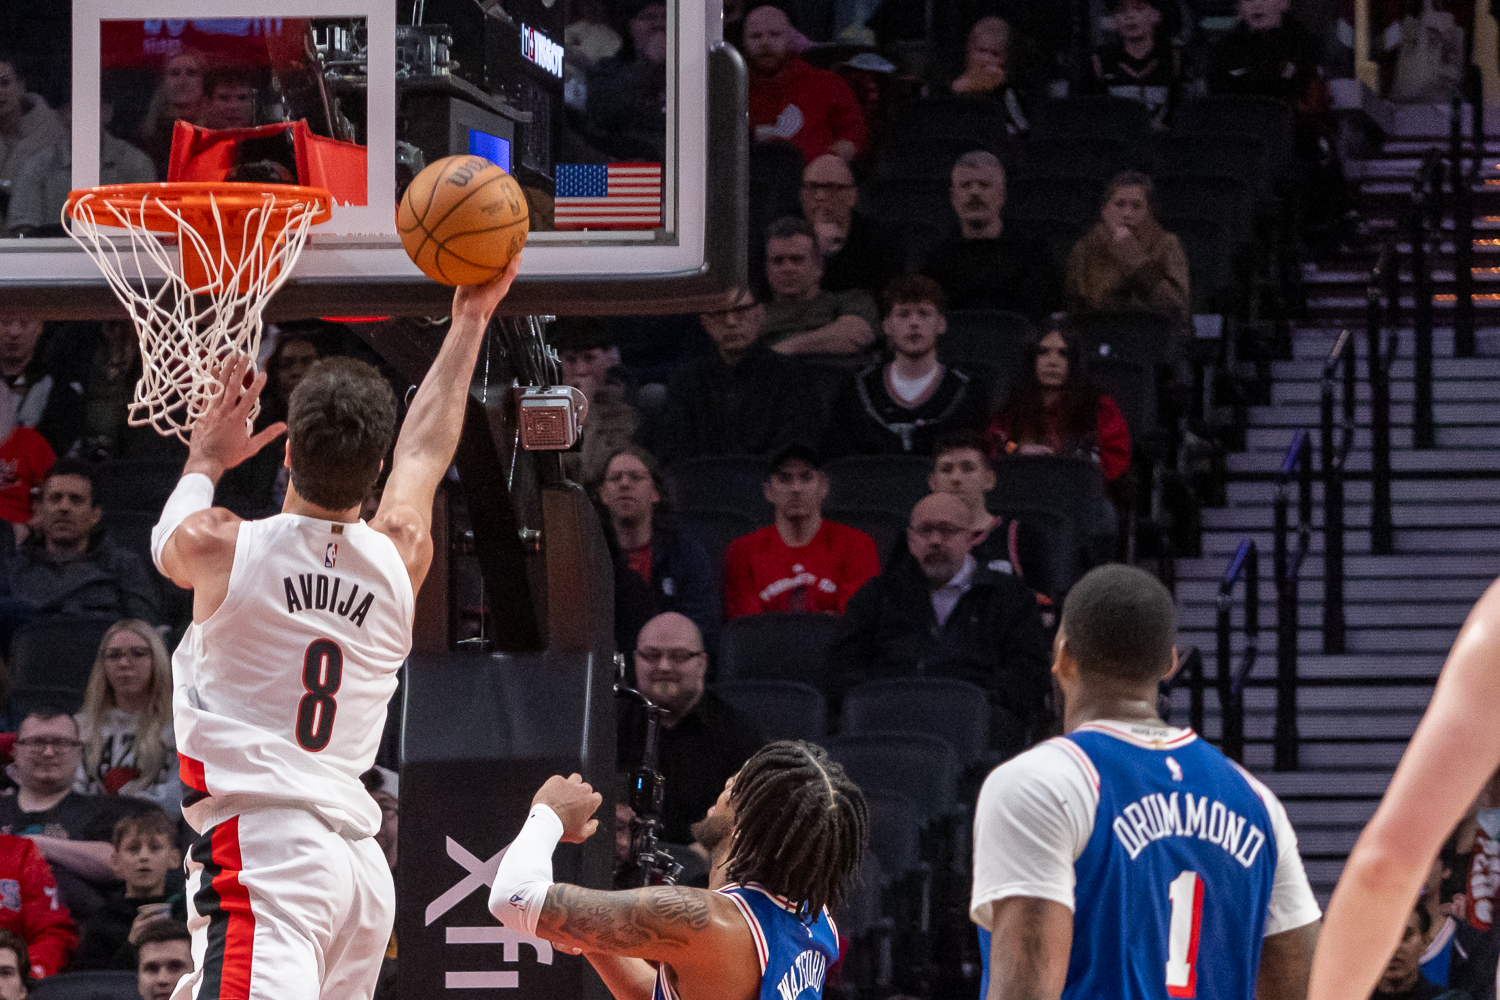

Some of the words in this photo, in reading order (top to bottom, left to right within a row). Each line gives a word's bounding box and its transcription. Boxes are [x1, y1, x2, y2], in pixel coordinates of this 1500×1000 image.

[534, 30, 564, 78] TISSOT
[283, 573, 375, 628] AVDIJA
[295, 638, 343, 752] 8
[1112, 792, 1266, 868] DRUMMOND
[1165, 871, 1204, 998] 1
